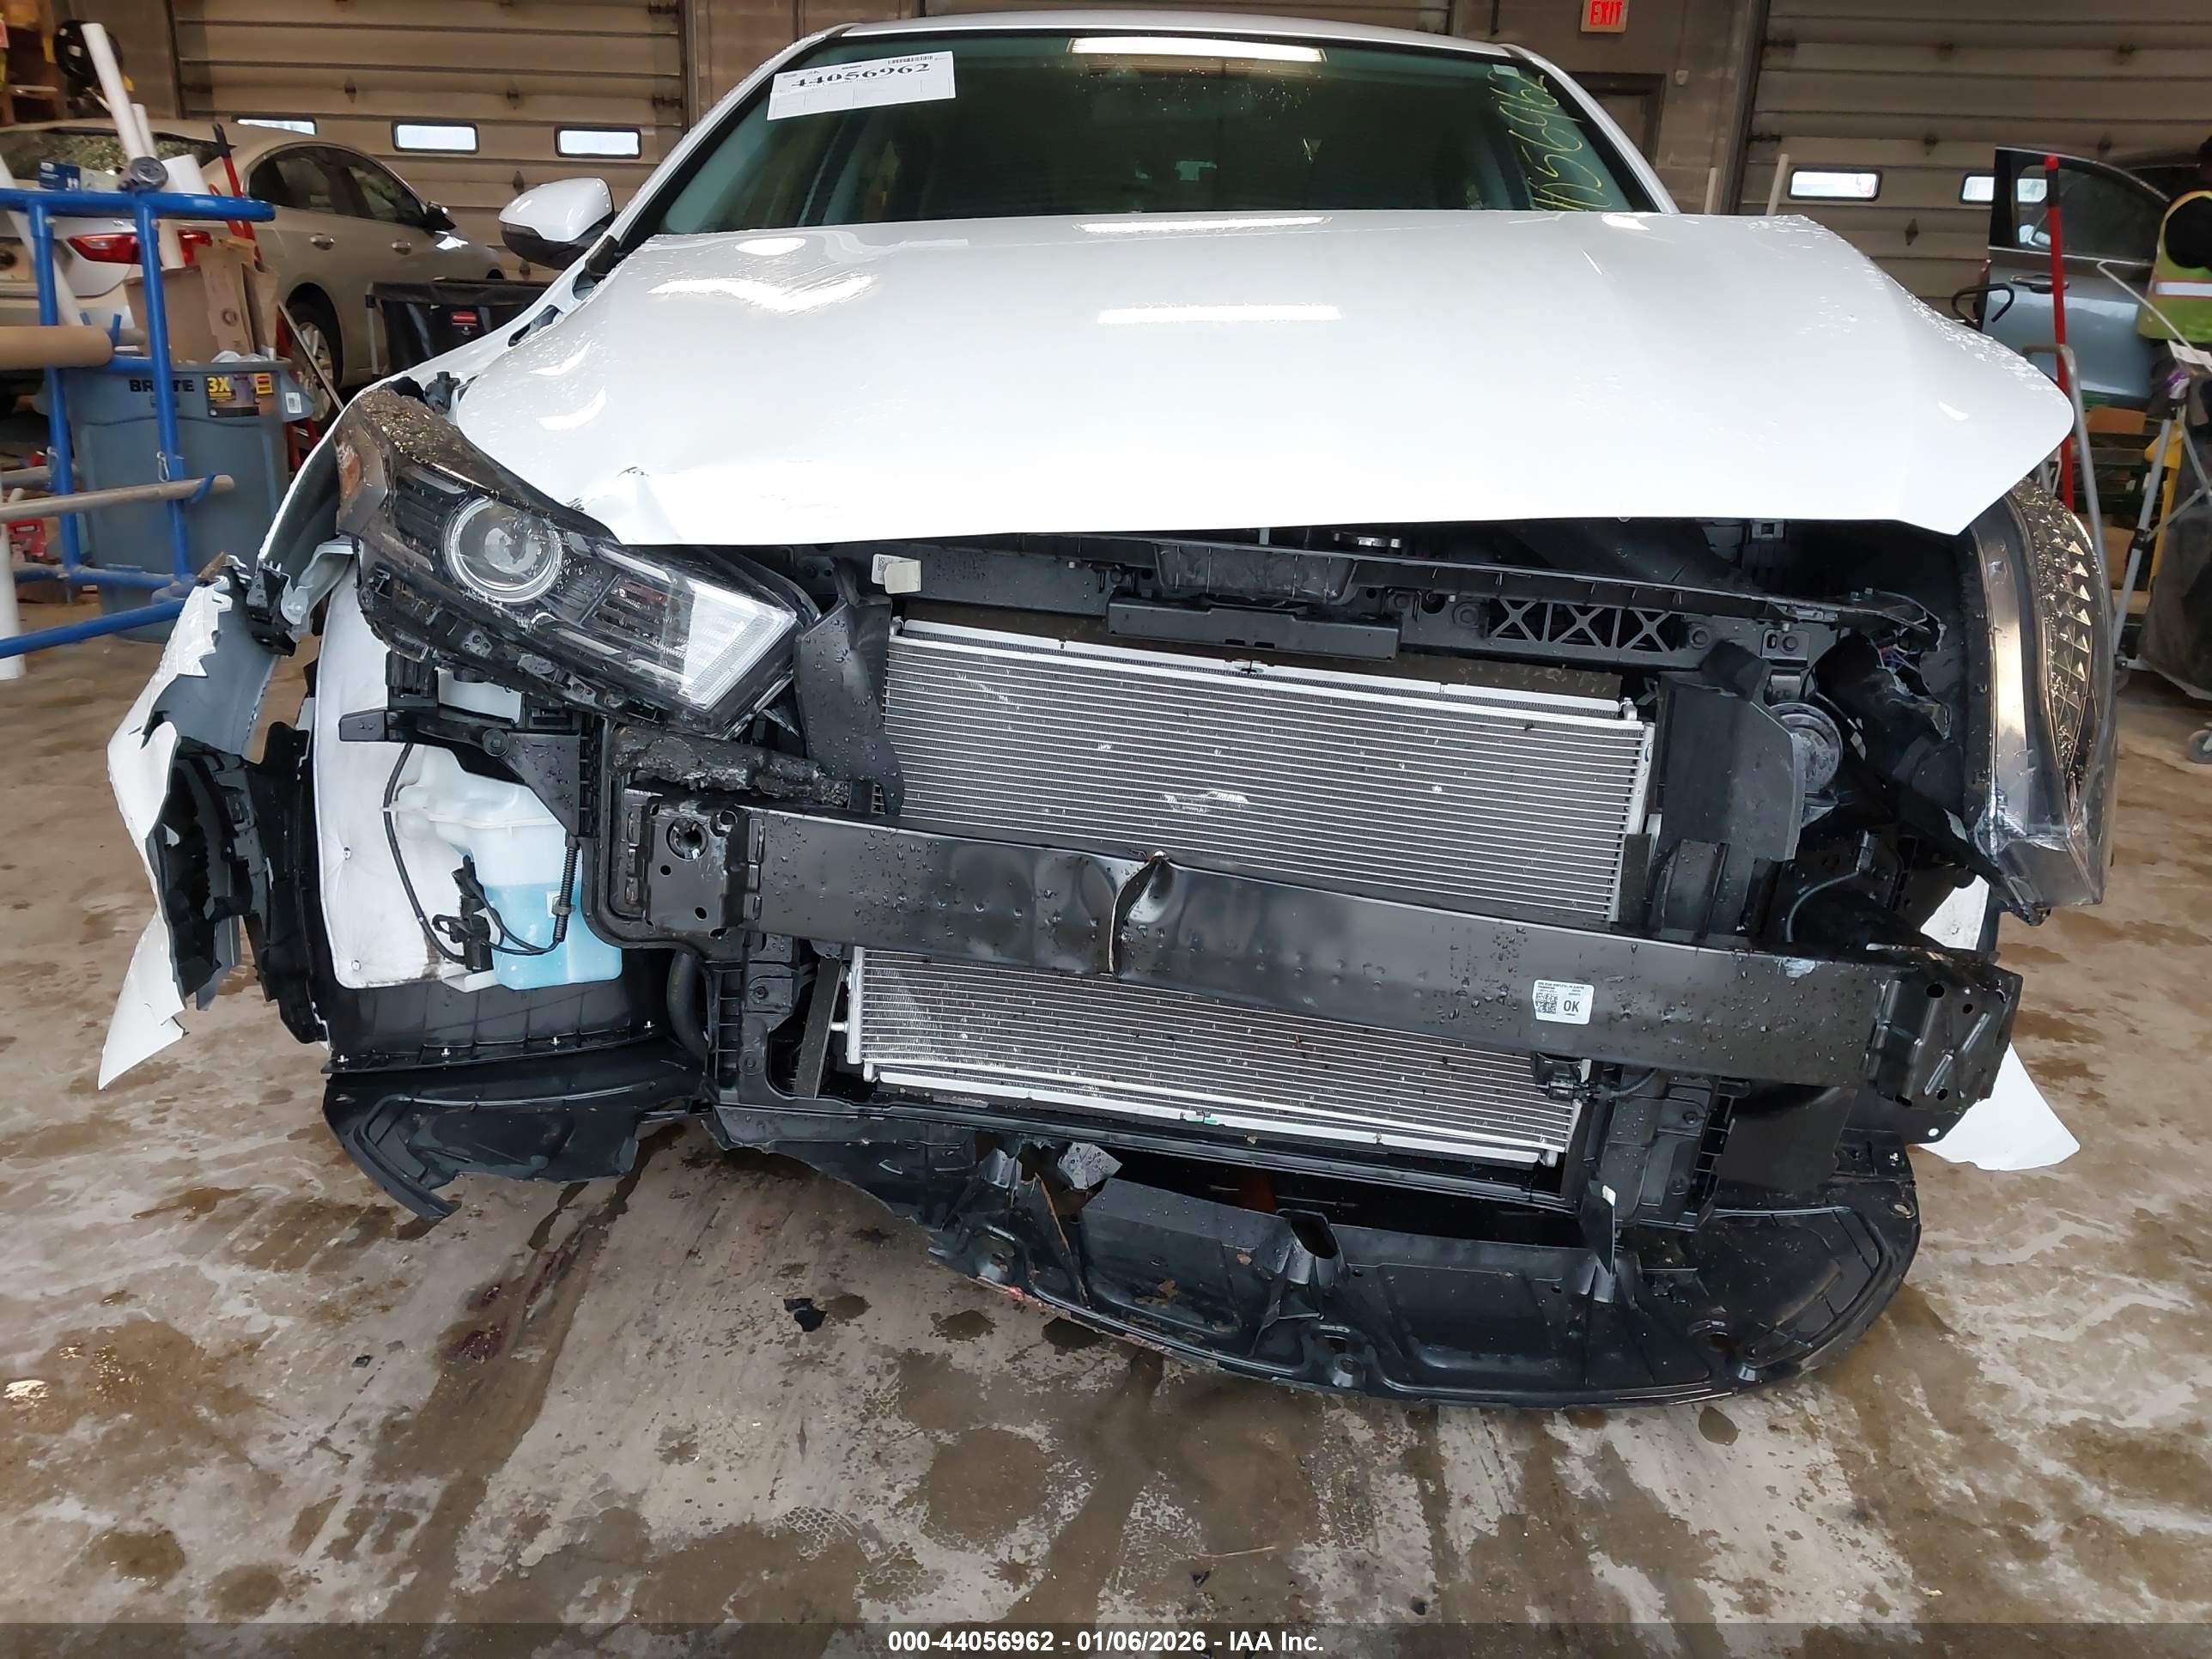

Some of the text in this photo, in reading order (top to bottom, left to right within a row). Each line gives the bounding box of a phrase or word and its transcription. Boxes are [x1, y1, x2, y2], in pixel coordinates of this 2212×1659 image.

[1589, 0, 1622, 27] EXIT
[791, 63, 931, 87] 44056962
[129, 379, 195, 392] BRTE
[206, 377, 231, 392] 3X
[1563, 1000, 1580, 1012] OK
